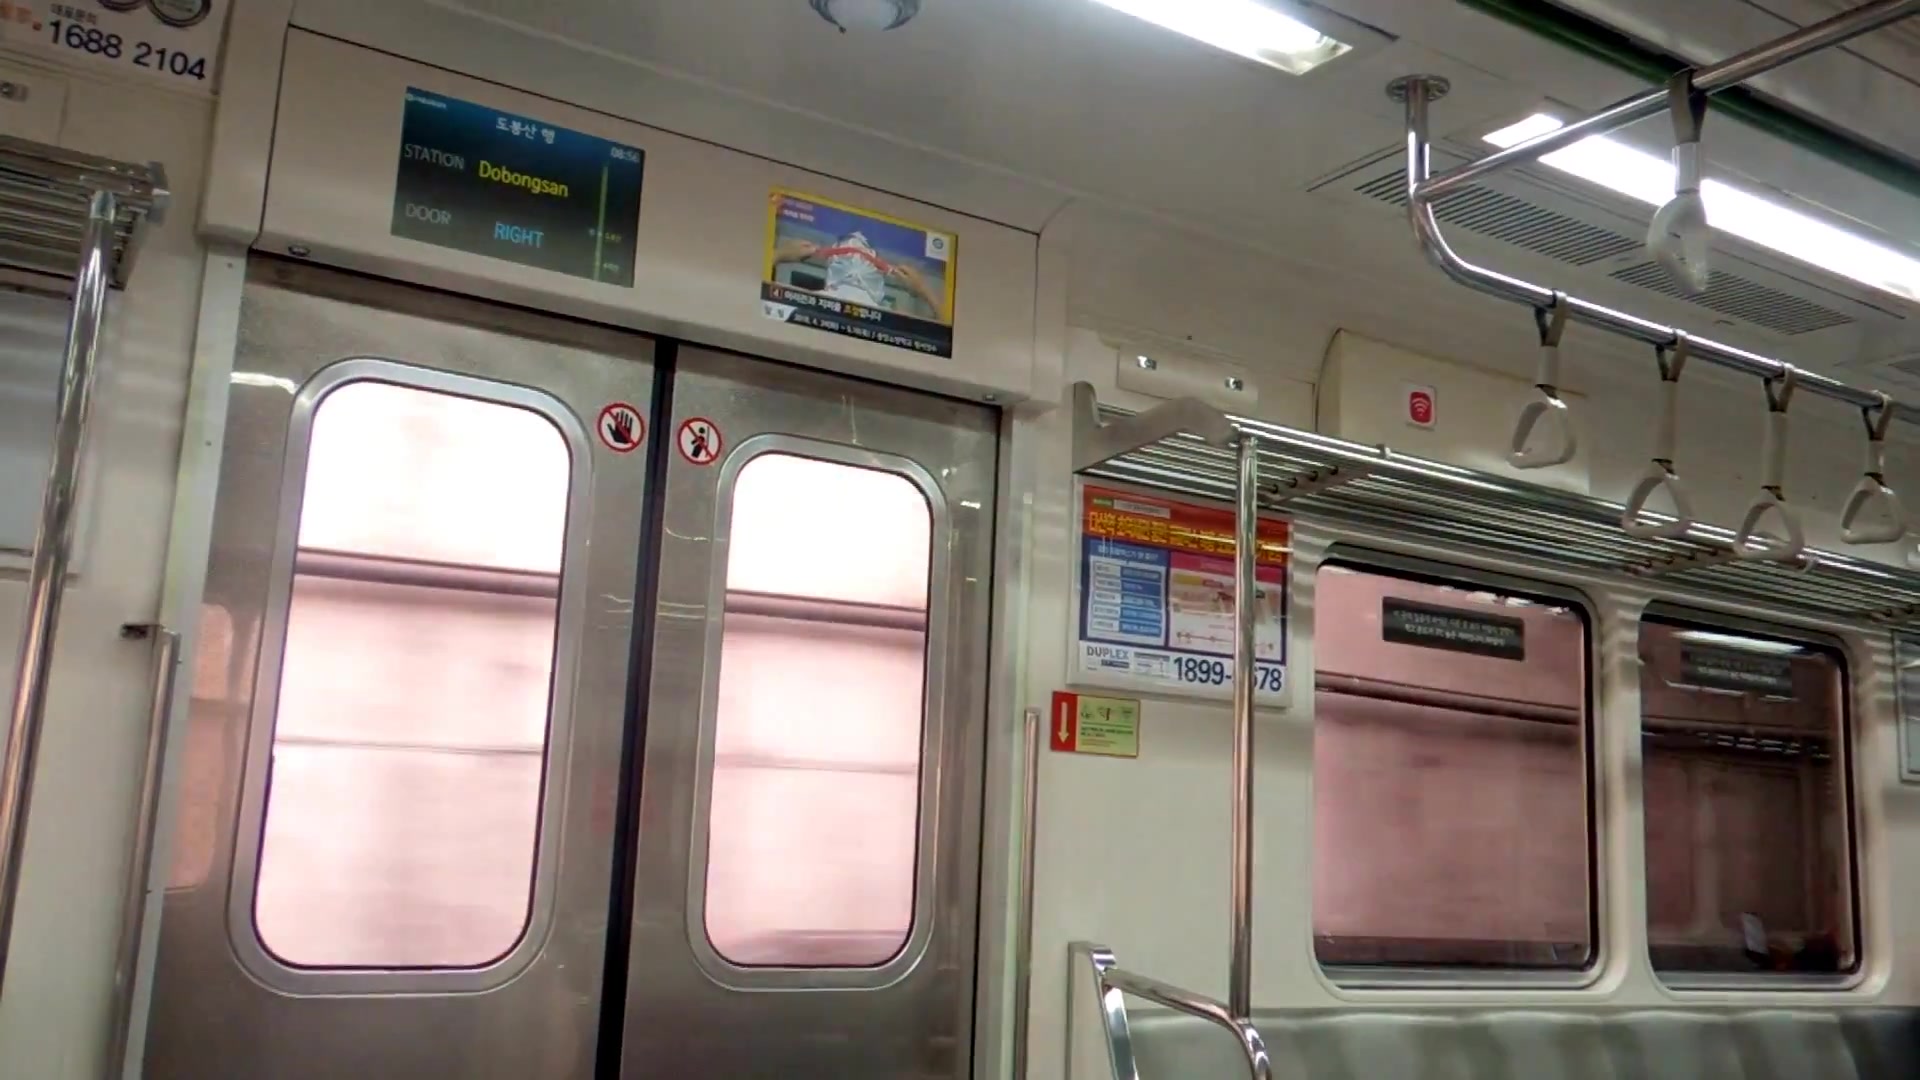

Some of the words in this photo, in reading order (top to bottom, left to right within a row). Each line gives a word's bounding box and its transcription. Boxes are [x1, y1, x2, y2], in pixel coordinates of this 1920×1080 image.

[49, 20, 123, 59] 1688
[133, 42, 206, 81] 2104
[496, 116, 538, 140] 도봉산
[403, 143, 465, 170] STATION
[478, 159, 569, 198] Dobongsan
[404, 203, 452, 226] DOOR
[493, 220, 545, 249] RIGHT
[1086, 645, 1130, 660] DUPLEX
[1172, 656, 1282, 693] 1899-78
